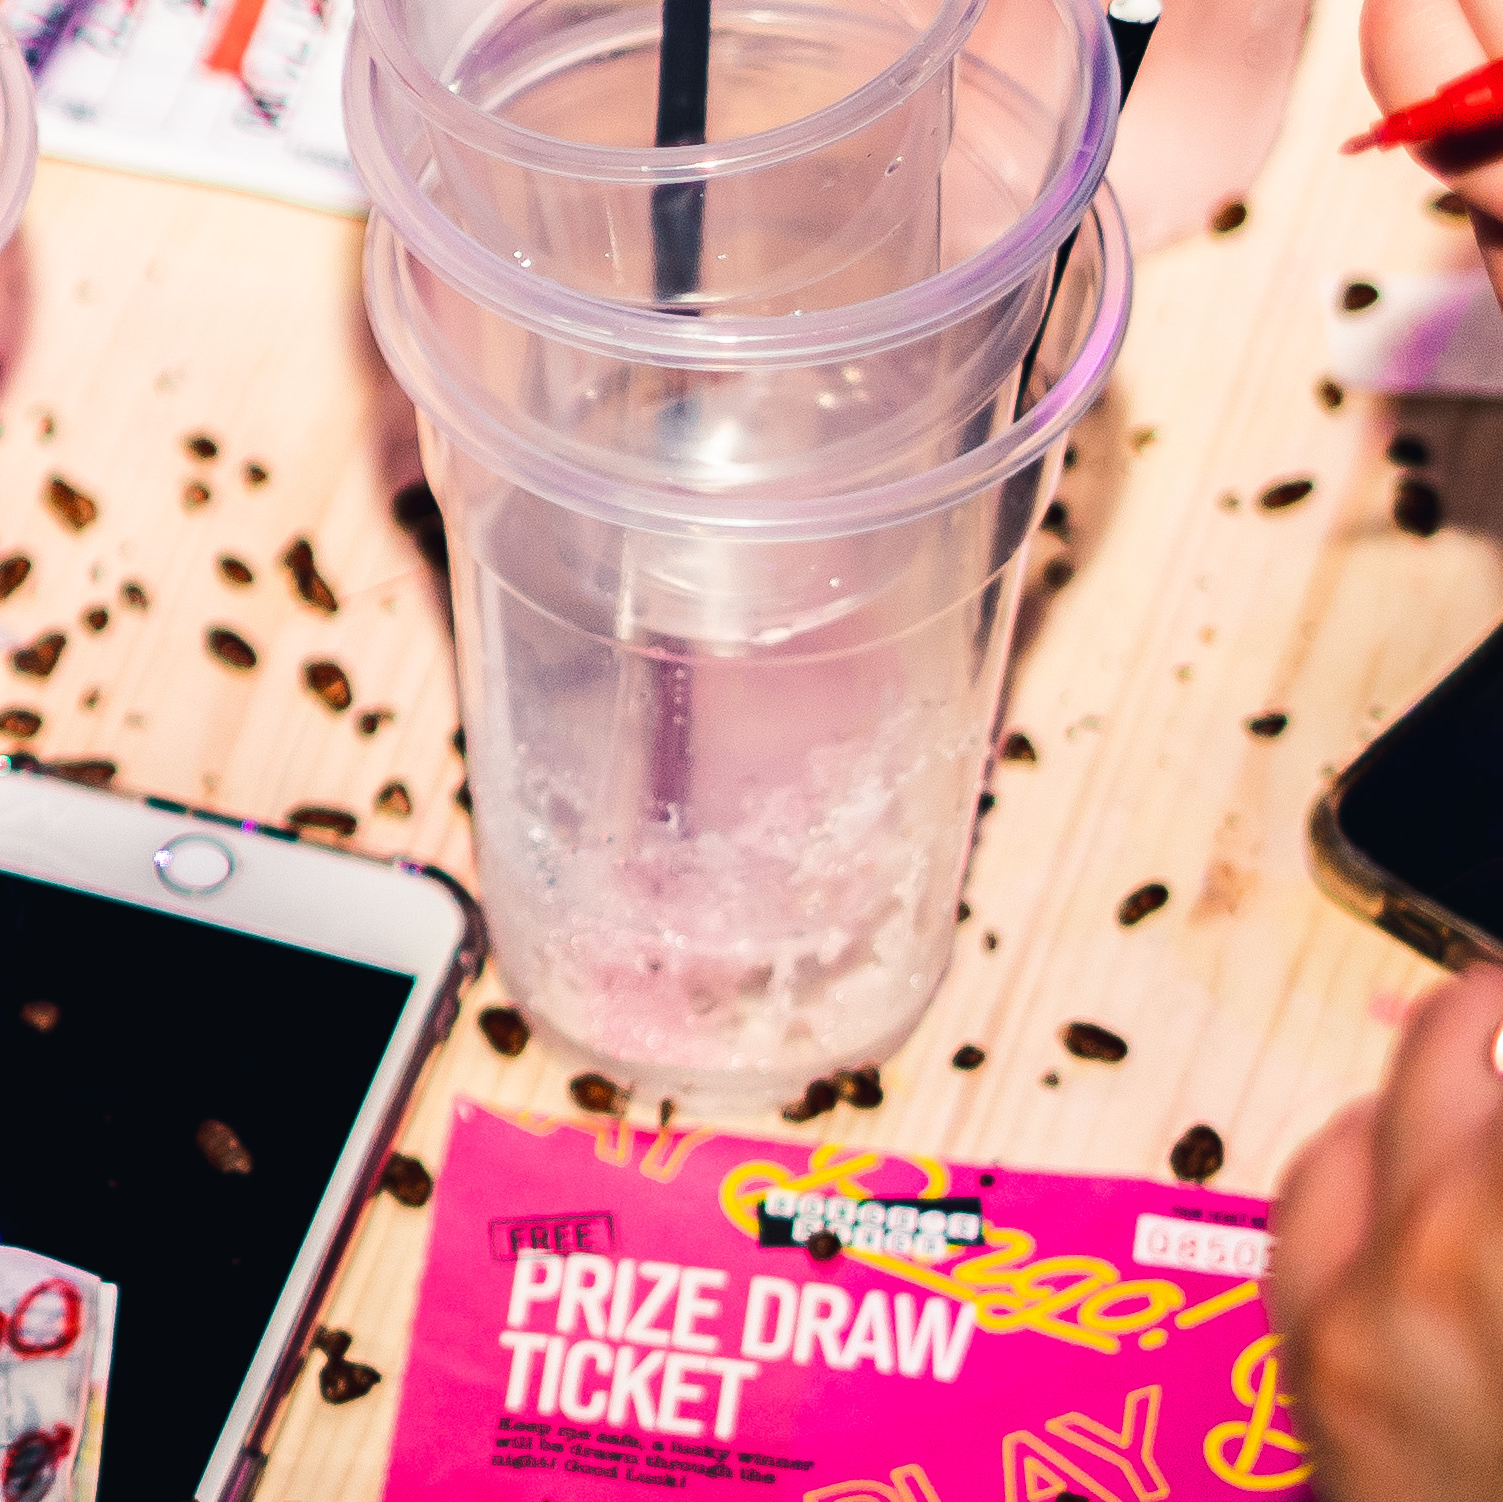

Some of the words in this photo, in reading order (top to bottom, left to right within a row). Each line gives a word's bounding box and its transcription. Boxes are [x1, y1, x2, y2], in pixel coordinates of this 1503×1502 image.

[510, 1222, 595, 1252] FREE
[507, 1248, 729, 1352] PRIZE
[741, 1276, 978, 1383] DRAW
[500, 1330, 761, 1442] TICKET
